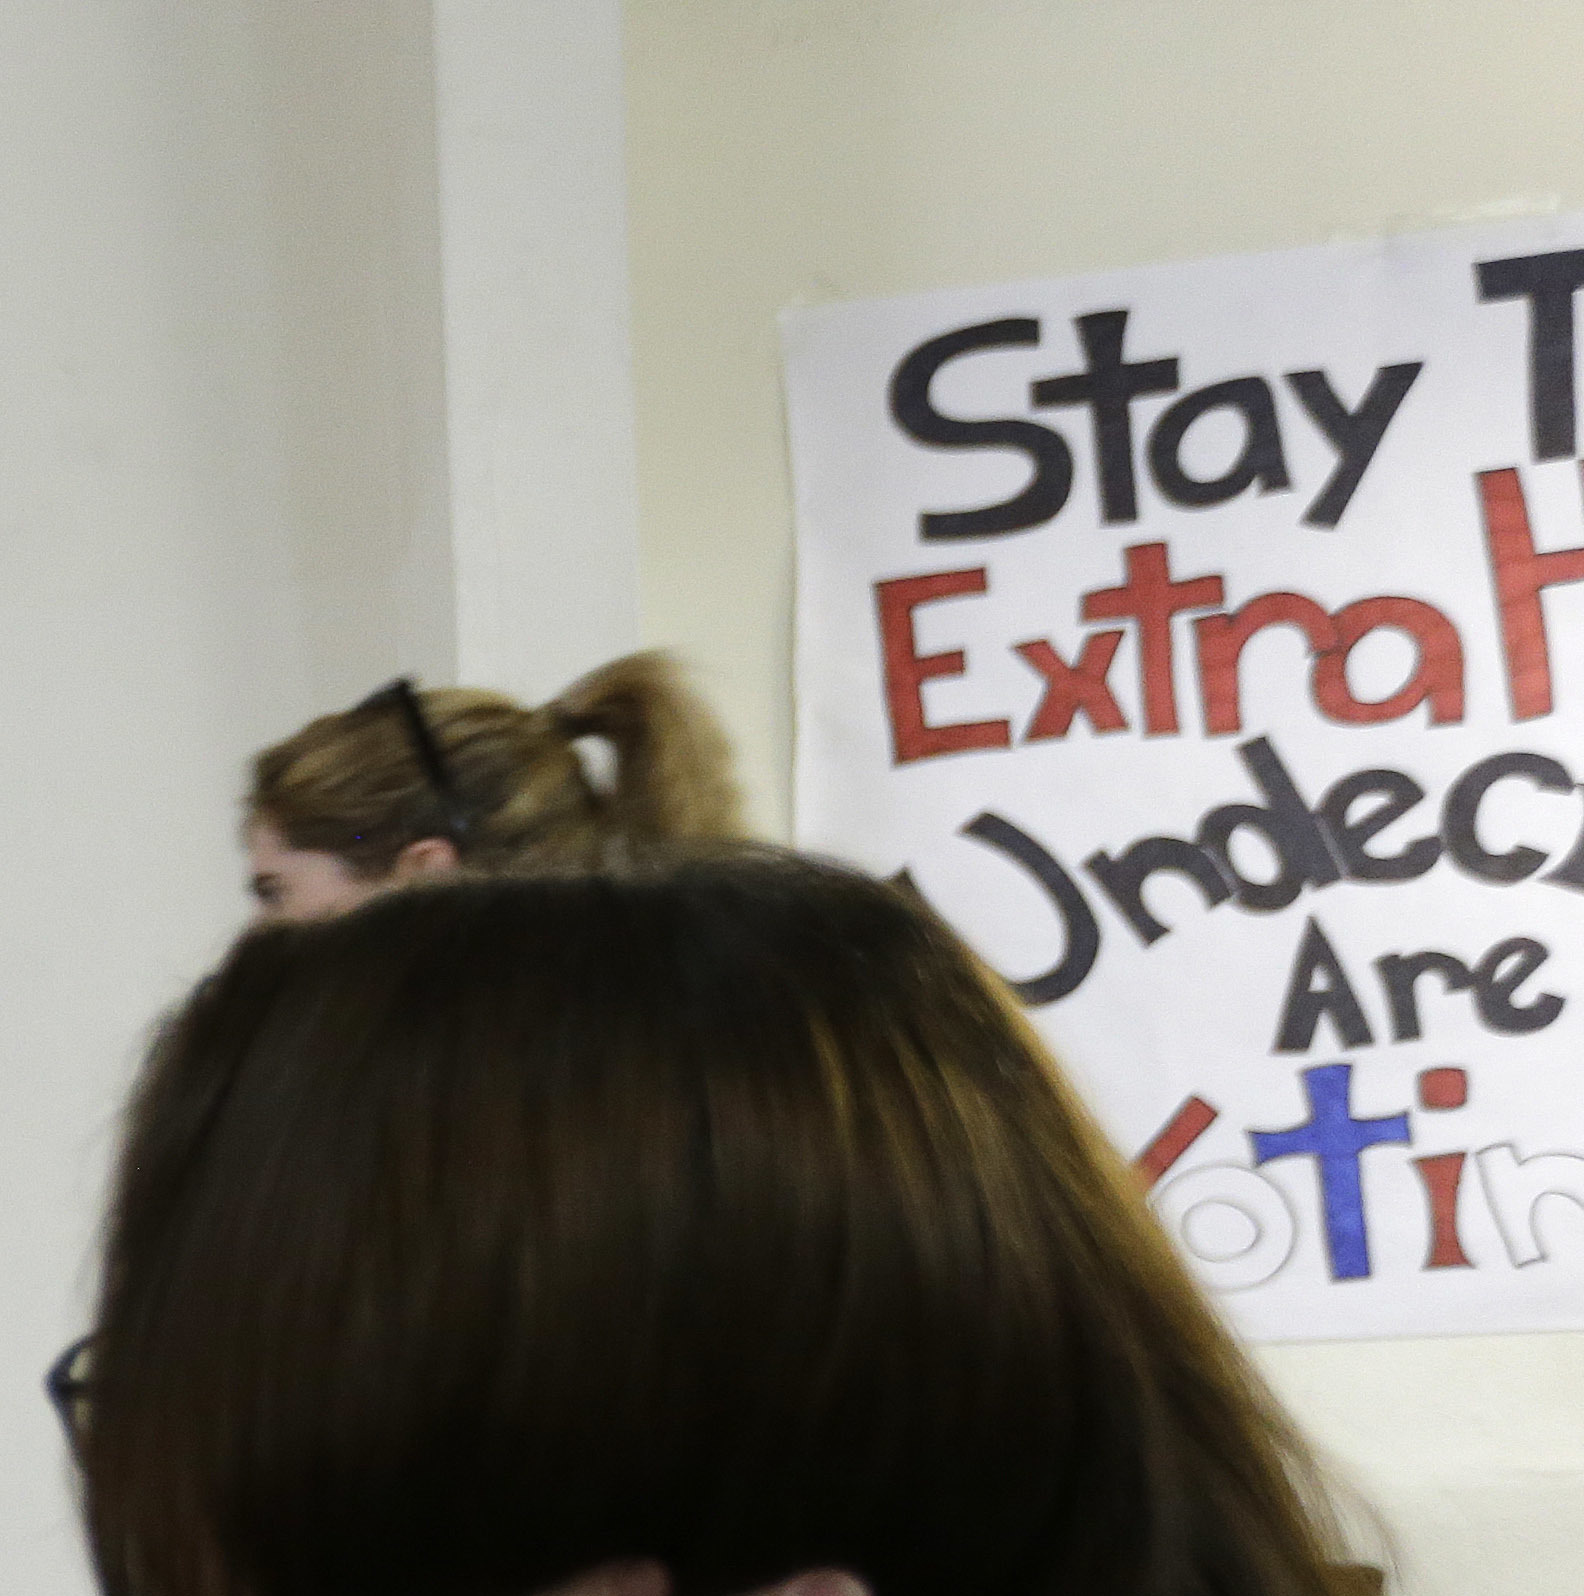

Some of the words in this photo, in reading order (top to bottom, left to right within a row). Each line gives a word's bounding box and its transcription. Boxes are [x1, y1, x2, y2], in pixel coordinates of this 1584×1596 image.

[888, 309, 1424, 543] Stay
[874, 540, 1465, 767] Extra
[894, 735, 1584, 1007] Undec
[1272, 914, 1564, 1055] Are
